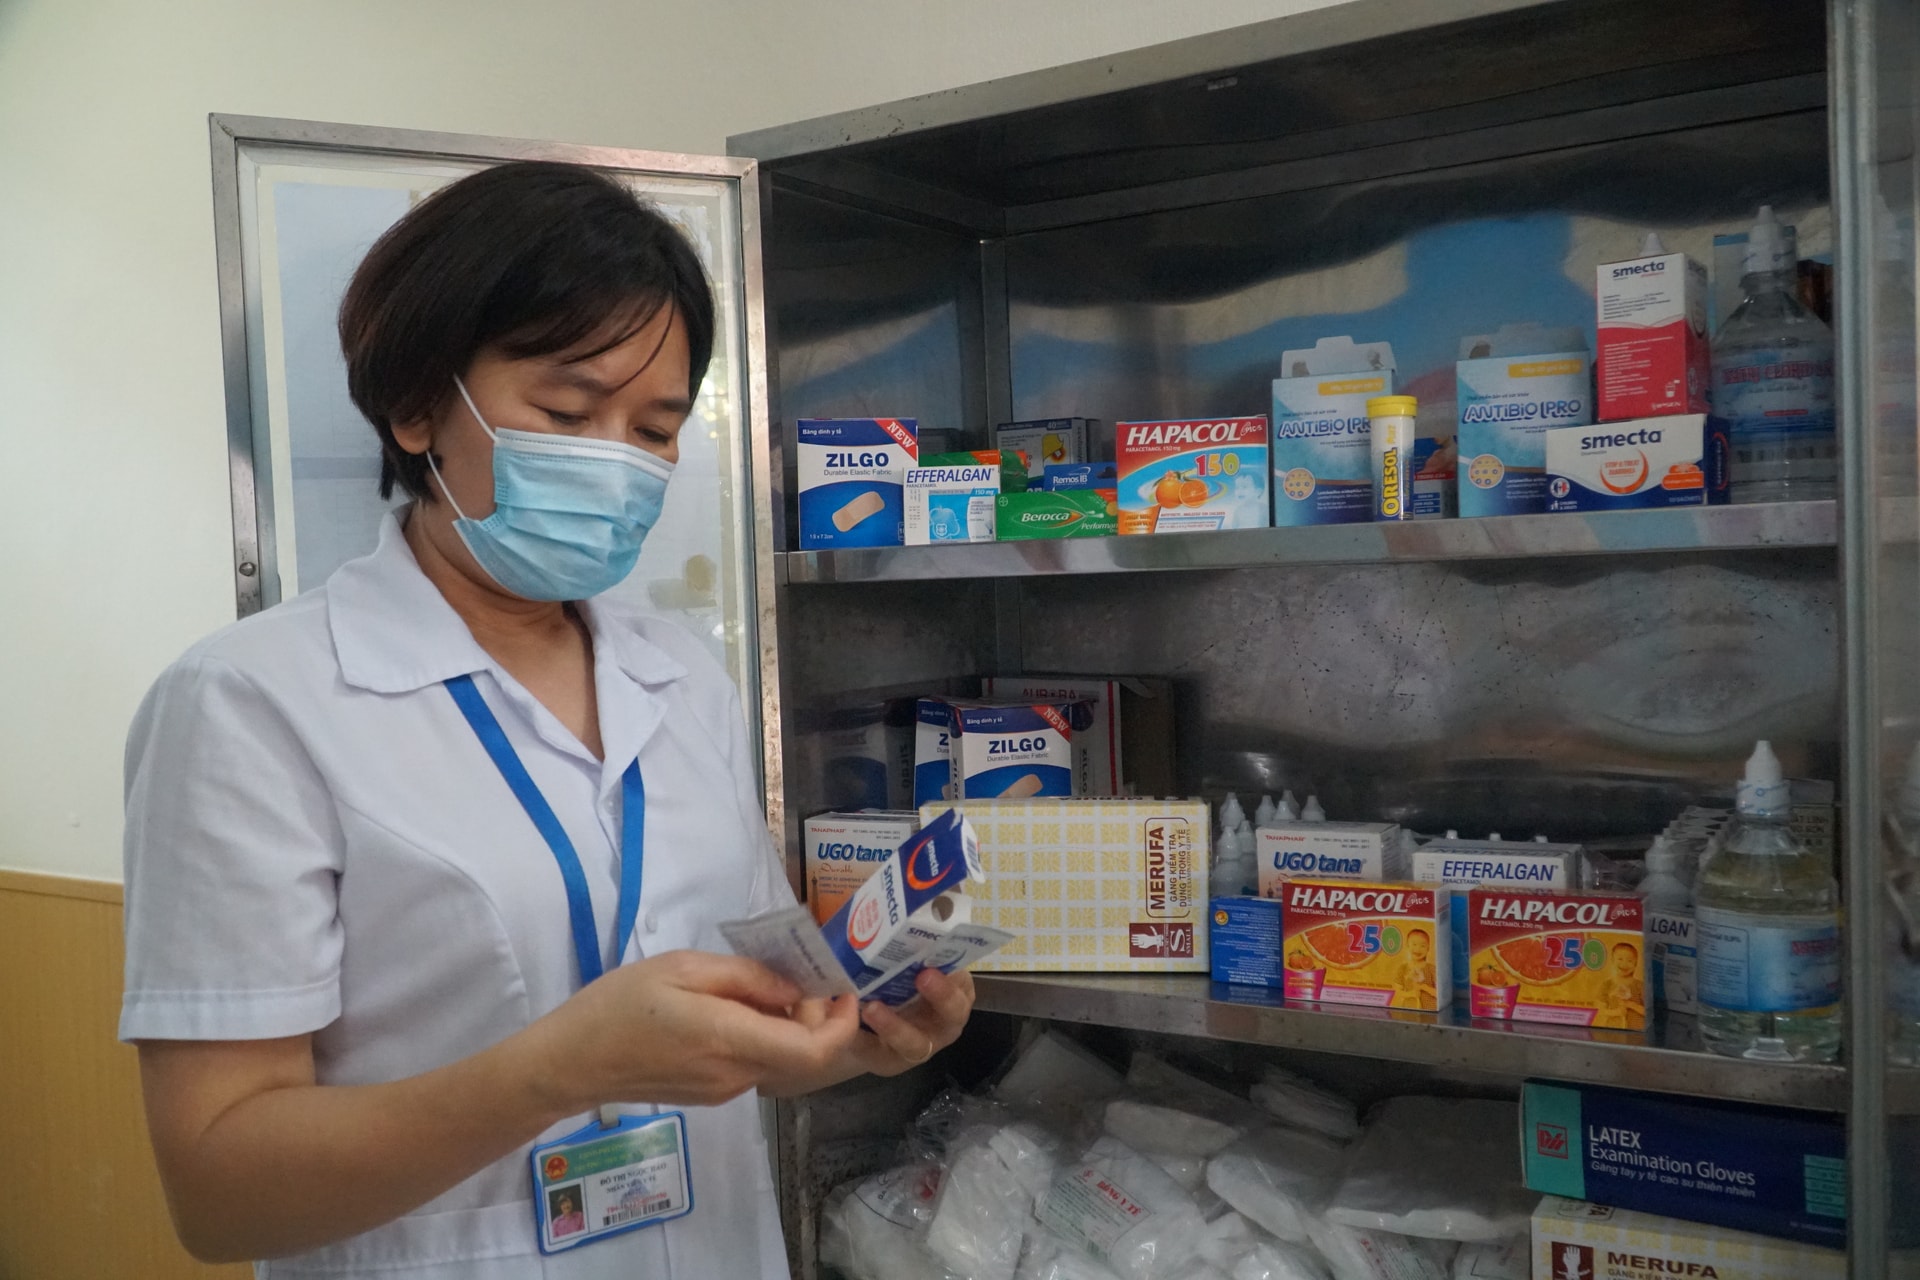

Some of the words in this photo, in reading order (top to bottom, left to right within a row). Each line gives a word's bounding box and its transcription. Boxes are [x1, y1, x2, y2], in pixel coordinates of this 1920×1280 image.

[1613, 261, 1665, 279] smecta
[887, 421, 915, 448] NEW
[1126, 422, 1241, 446] HAPACOL
[1347, 416, 1372, 434] PR
[1581, 429, 1662, 450] smecta
[826, 452, 890, 468] ZILGO
[1195, 453, 1241, 477] 150
[850, 469, 871, 477] Elastic
[906, 467, 992, 484] EFFERALGAN
[1053, 476, 1079, 485] Remos
[1079, 475, 1089, 484] IB
[1382, 447, 1400, 517] ORESOL
[1021, 512, 1070, 523] Berocca
[1081, 522, 1118, 531] Performan
[1044, 707, 1069, 732] NEW
[989, 737, 1047, 754] ZILGO
[987, 755, 1010, 763] Durable
[1031, 752, 1049, 760] Fabric
[1168, 833, 1177, 851] TRA
[1176, 828, 1186, 839] TẾ
[927, 839, 939, 877] smecta
[1149, 826, 1166, 910] MERUFA
[1178, 850, 1187, 880] TRONG
[1442, 860, 1554, 881] EFFERALGAN
[884, 864, 899, 927] smecta
[1290, 887, 1409, 914] HAPACOL
[1290, 907, 1326, 916] PARACETAMOL
[1480, 897, 1613, 925] HAPACOL
[907, 927, 942, 941] smec
[1480, 919, 1521, 929] PARACETAMOL
[1651, 919, 1690, 938] LGAN
[1170, 929, 1186, 953] S
[1347, 923, 1402, 956] 250
[1545, 936, 1607, 971] 250
[1590, 1124, 1642, 1150] LATEX
[1590, 1142, 1692, 1175] Examination
[1696, 1160, 1756, 1186] Gloves
[1619, 1166, 1636, 1179] tay
[1638, 1170, 1646, 1181] y
[1660, 1174, 1679, 1186] cao
[1607, 1251, 1718, 1280] MERUFA
